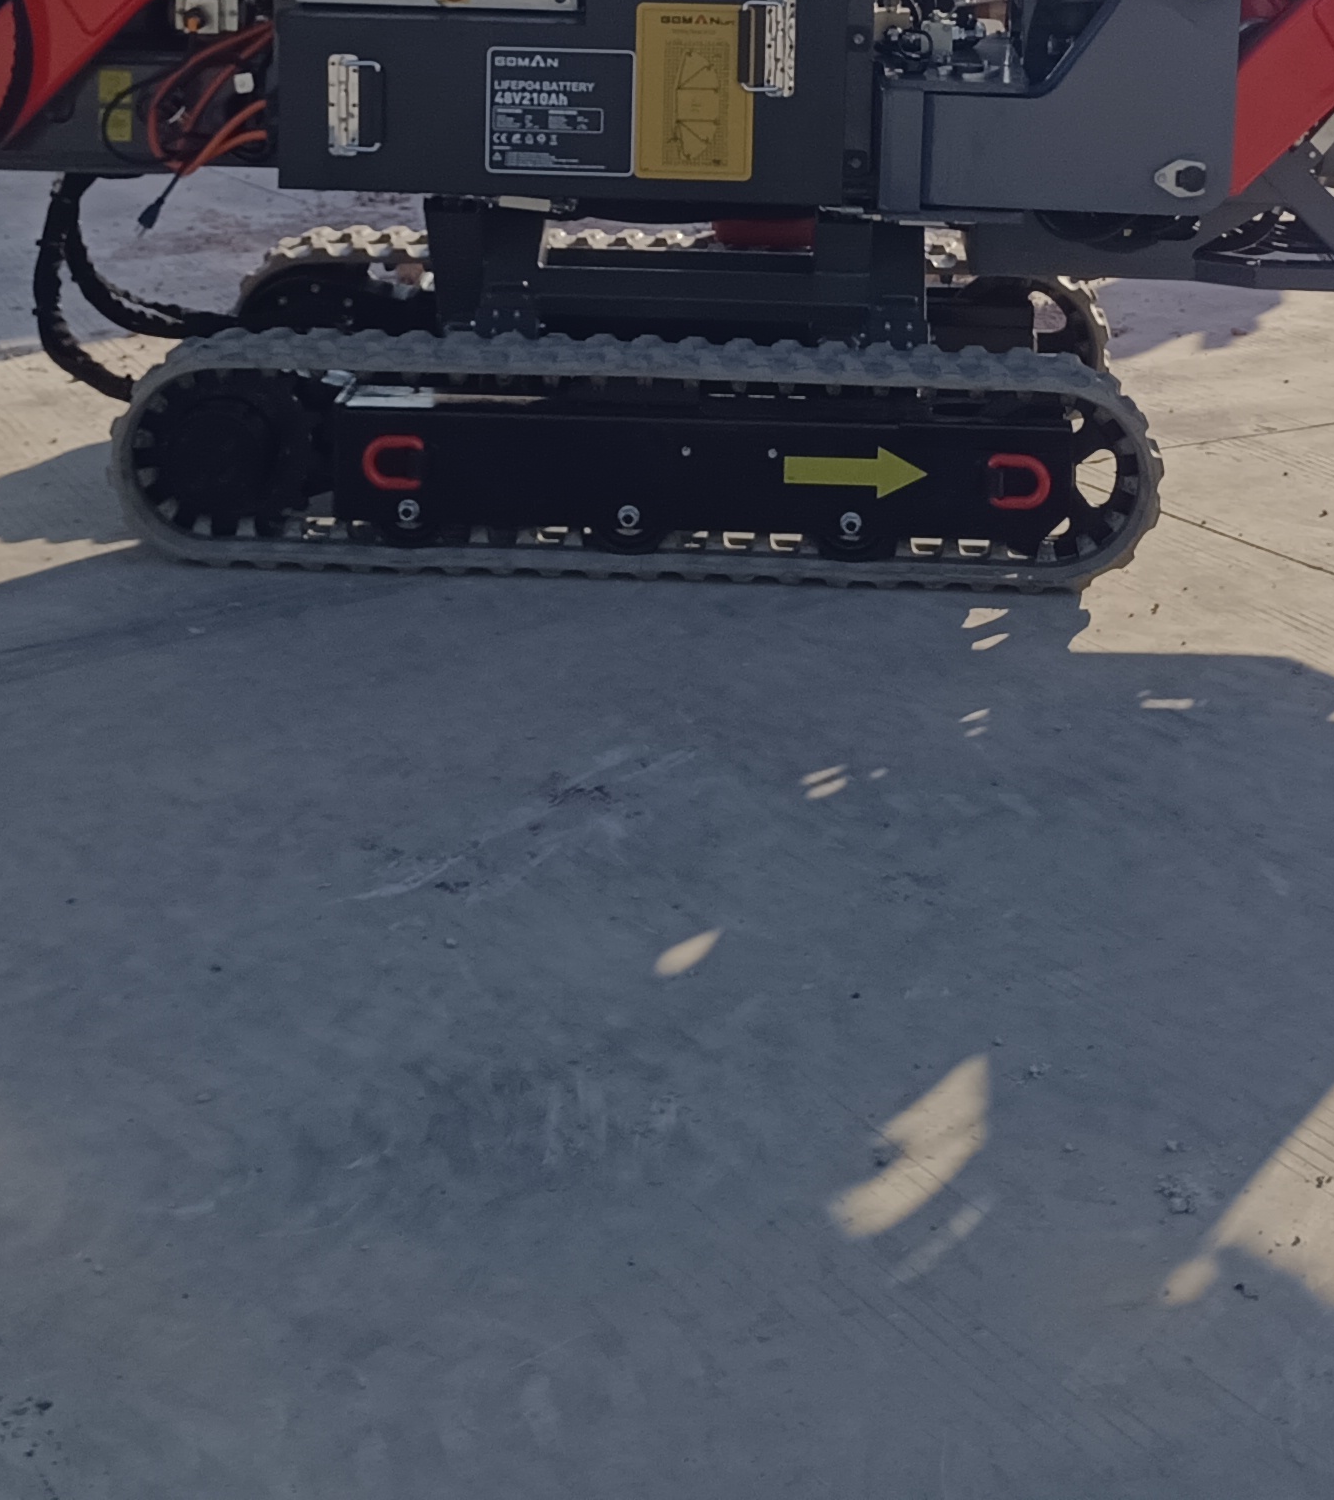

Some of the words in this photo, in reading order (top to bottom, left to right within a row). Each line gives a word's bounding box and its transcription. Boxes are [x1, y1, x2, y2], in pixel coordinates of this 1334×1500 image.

[494, 55, 559, 68] GOMAN
[542, 81, 596, 93] BATTERY
[494, 92, 568, 106] 48V210Ah
